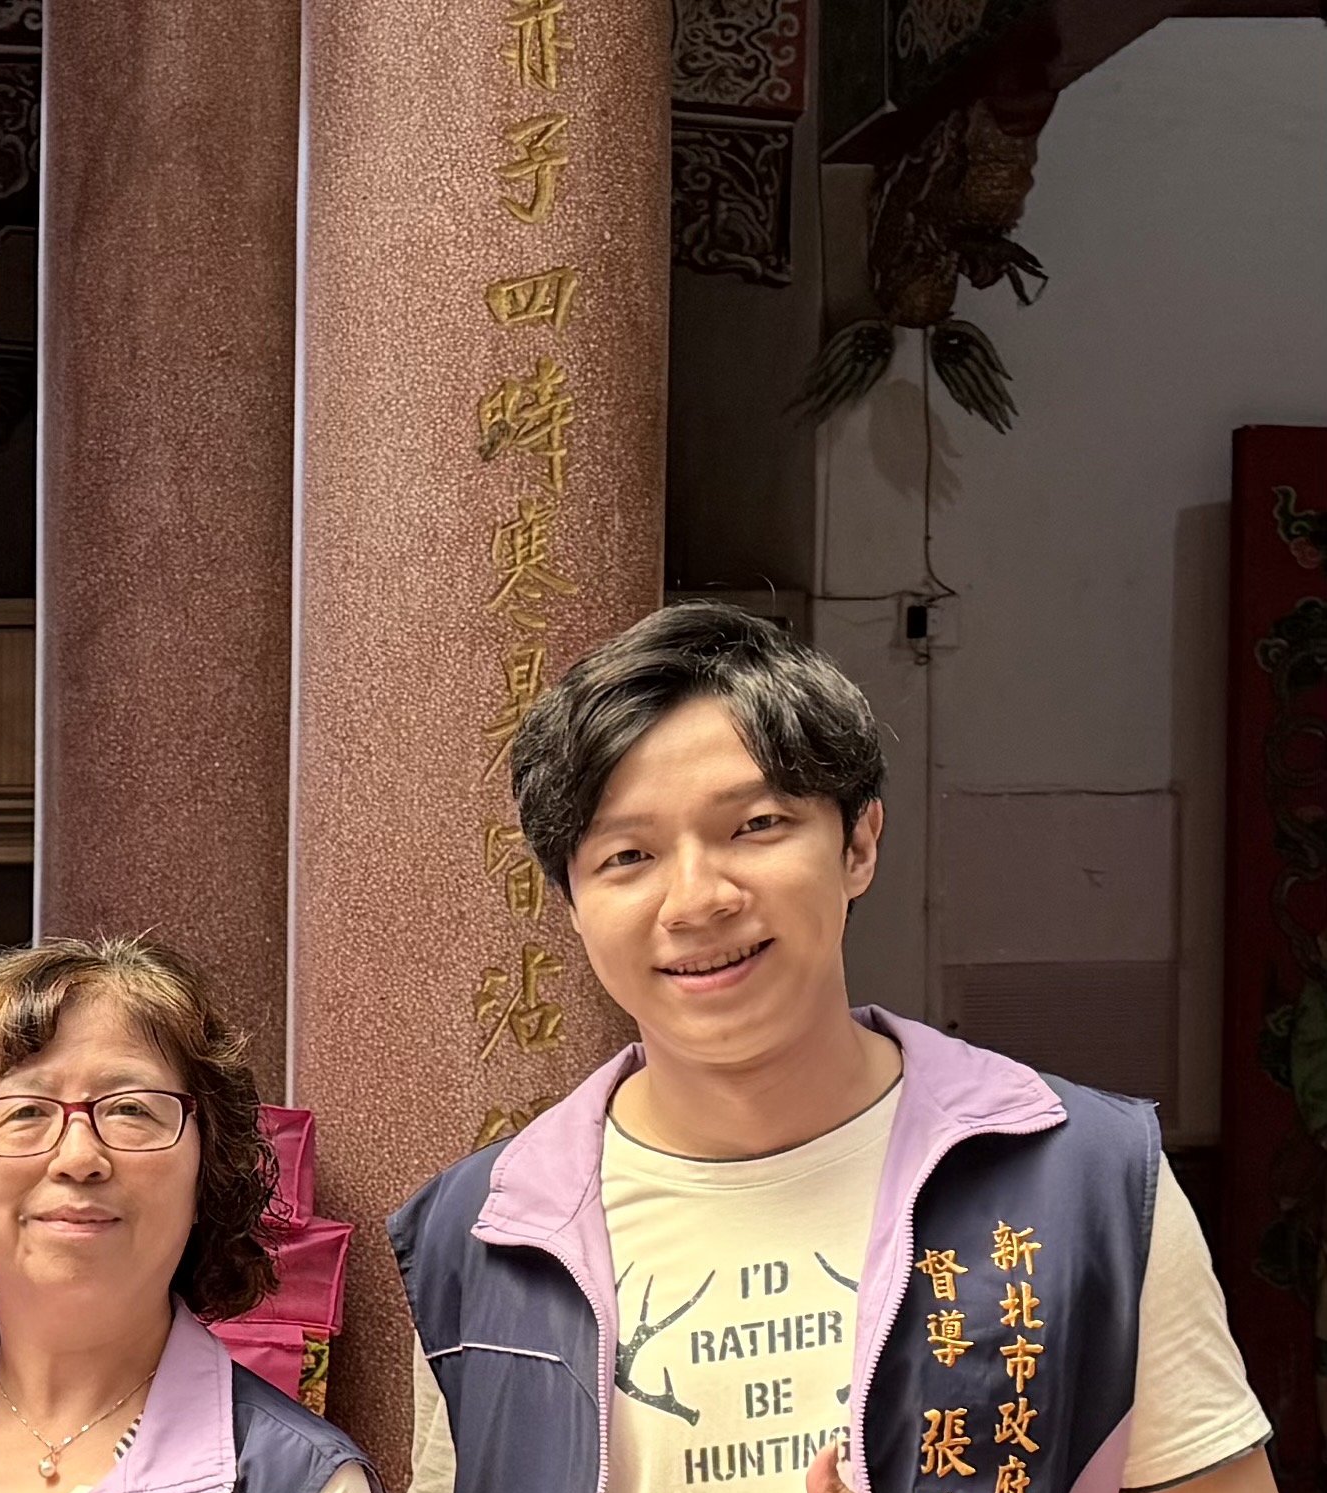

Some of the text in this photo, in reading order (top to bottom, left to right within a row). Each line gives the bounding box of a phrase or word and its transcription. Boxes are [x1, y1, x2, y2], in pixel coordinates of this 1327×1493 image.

[740, 1260, 789, 1300] I'D
[914, 1248, 975, 1369] 督導
[690, 1309, 843, 1365] RATHER
[745, 1377, 794, 1420] BE
